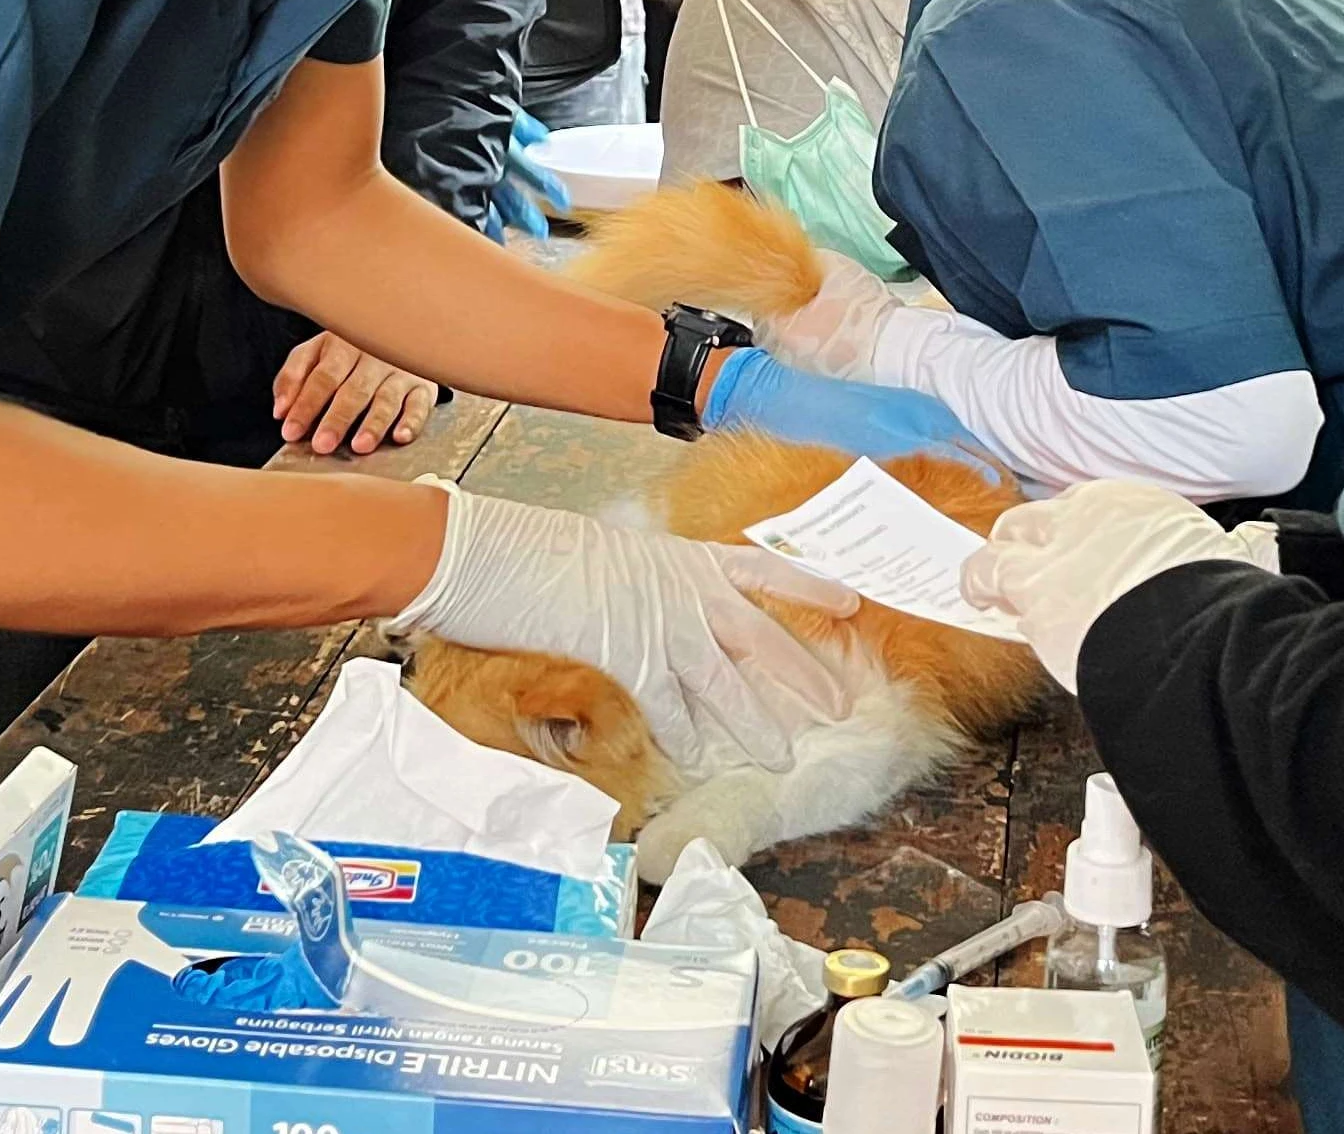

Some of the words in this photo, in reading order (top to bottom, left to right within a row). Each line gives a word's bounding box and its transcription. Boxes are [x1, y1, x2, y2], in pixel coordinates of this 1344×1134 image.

[503, 949, 597, 977] 100
[235, 1016, 348, 1035] Serbaguna
[350, 1023, 404, 1039] Nitril
[144, 1032, 239, 1054] Gloves
[408, 1029, 486, 1047] Tangan
[490, 1035, 564, 1054] Sarung
[244, 1039, 397, 1066] Disposable
[983, 1050, 1064, 1062] BIODIN
[399, 1052, 560, 1085] NITRILE
[974, 1112, 1053, 1126] COMPOSITION
